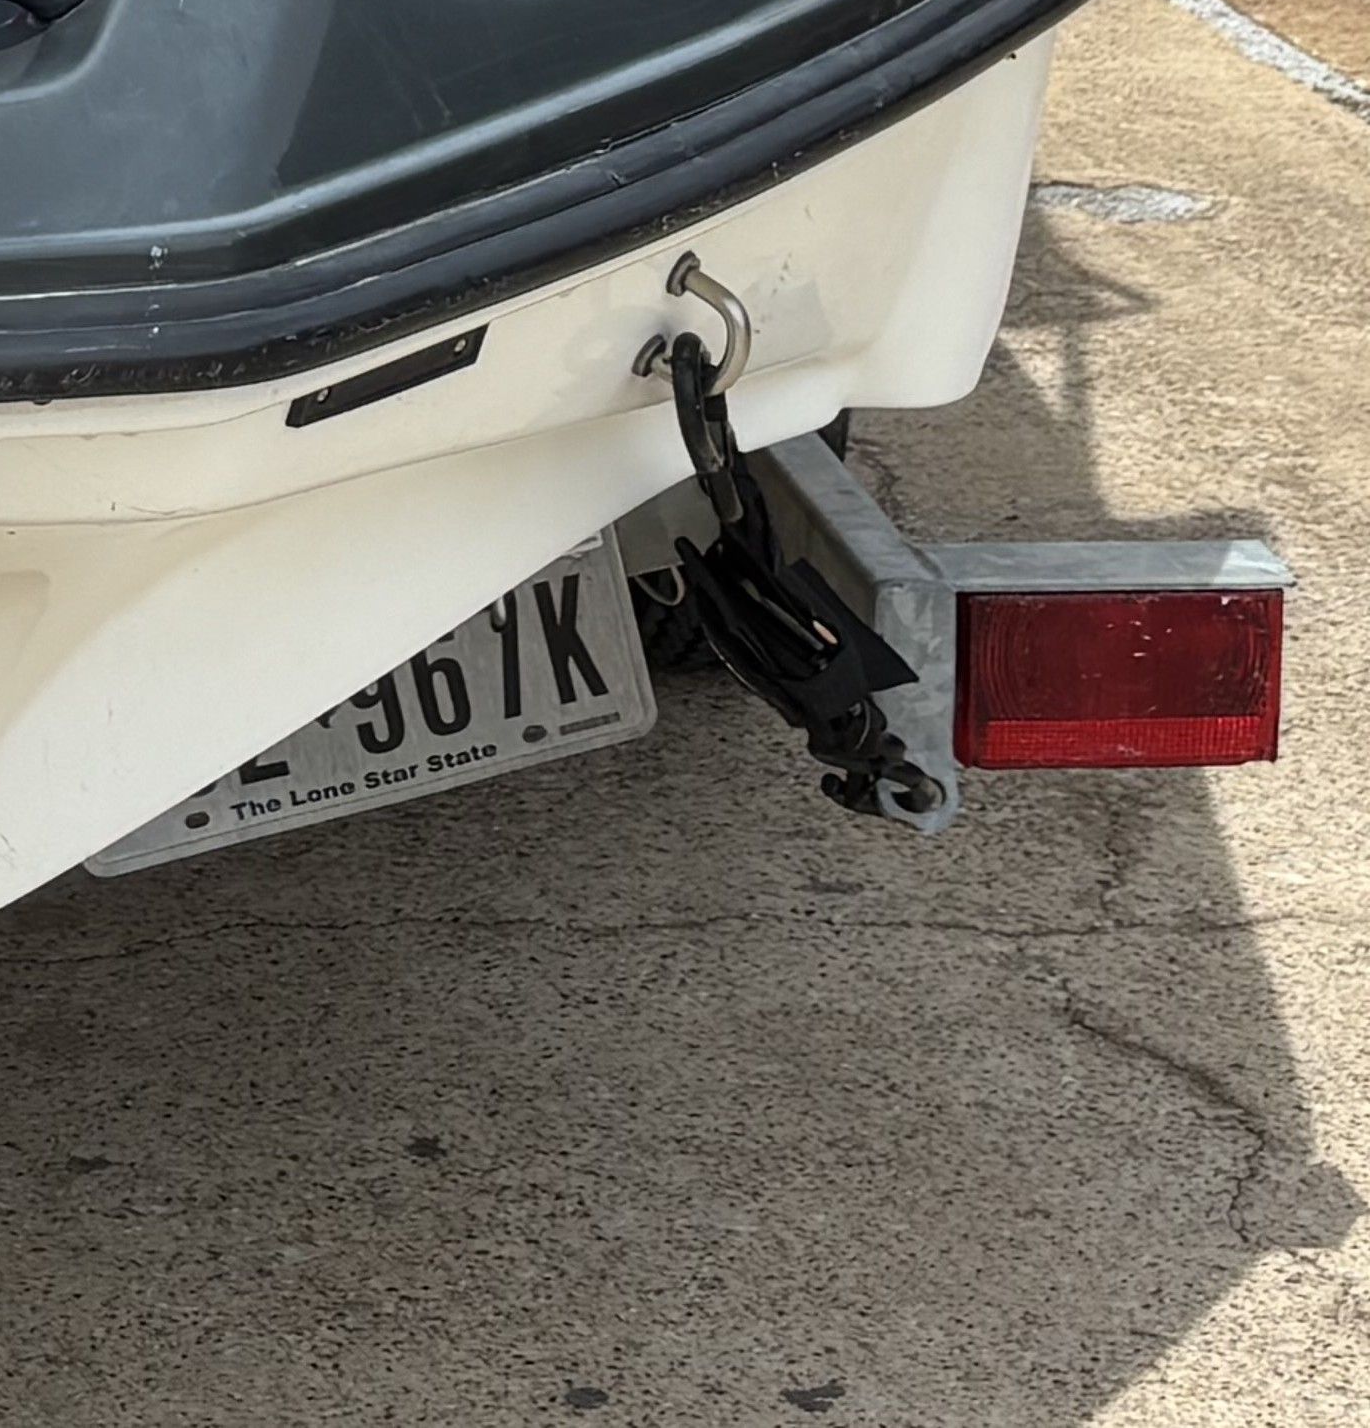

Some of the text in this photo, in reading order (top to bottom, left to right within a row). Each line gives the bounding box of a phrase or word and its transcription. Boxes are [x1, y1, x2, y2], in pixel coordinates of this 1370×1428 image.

[230, 743, 498, 821] The Lone Star State
